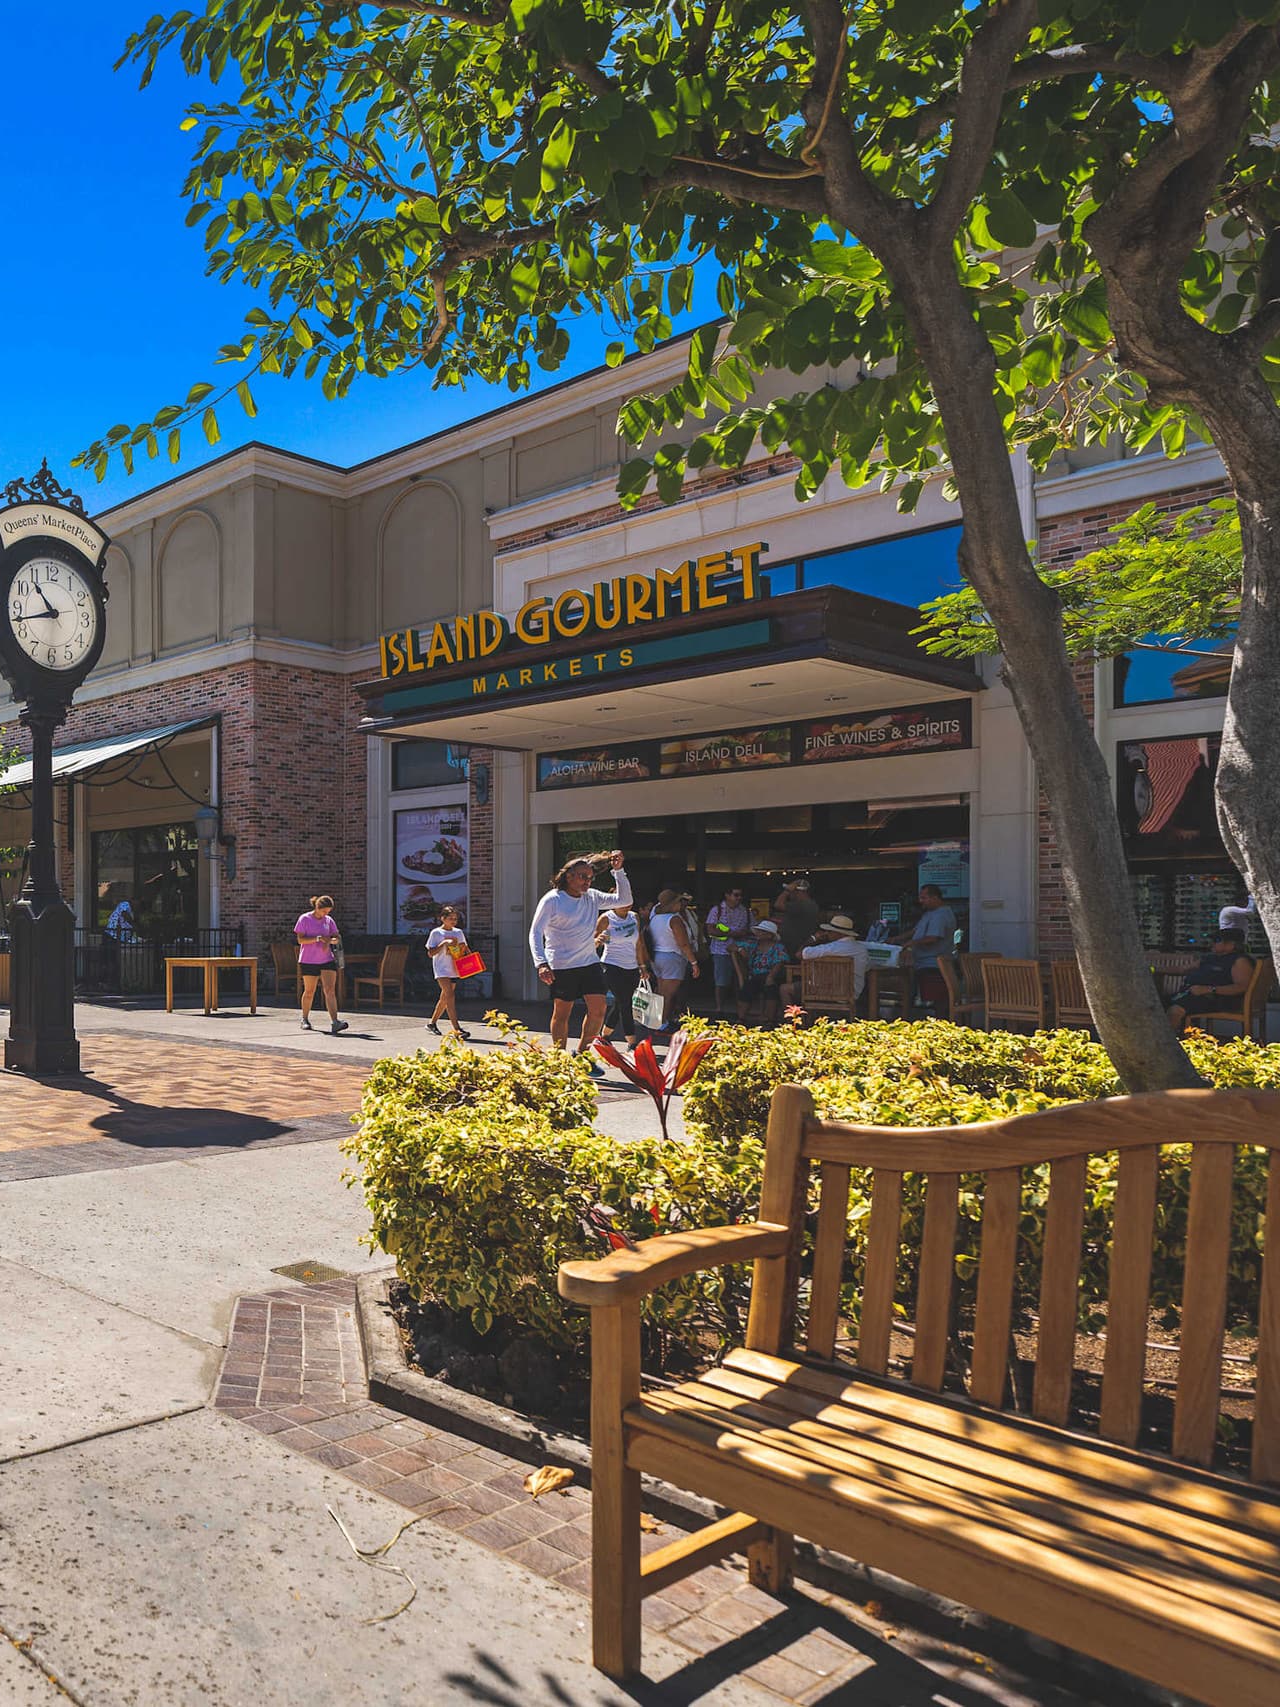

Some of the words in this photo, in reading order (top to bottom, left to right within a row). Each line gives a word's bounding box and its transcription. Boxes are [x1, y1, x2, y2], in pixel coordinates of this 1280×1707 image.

[3, 513, 39, 534] Queens'
[41, 513, 97, 551] MarketPlace
[30, 567, 39, 584] 11
[45, 565, 59, 582] 12
[17, 580, 29, 597] 10
[68, 575, 72, 592] 1
[76, 590, 86, 607] 2
[13, 600, 22, 619] 9
[378, 610, 508, 679] ISLAND
[514, 541, 770, 645] GOURMET
[80, 611, 90, 628] 3
[18, 622, 27, 639] 8
[30, 640, 39, 657] 7
[74, 632, 85, 648] 4
[47, 647, 57, 665] 6
[64, 644, 73, 661] 5
[472, 648, 634, 695] MARKETS
[805, 734, 837, 749] FINE
[839, 728, 886, 745] WINES
[891, 727, 902, 740] &
[907, 719, 960, 738] SPIRITS
[685, 747, 730, 763] ISLAND
[735, 743, 763, 758] DELI
[551, 763, 586, 777] ALOHA
[587, 759, 615, 773] WINE
[618, 757, 639, 769] BAR
